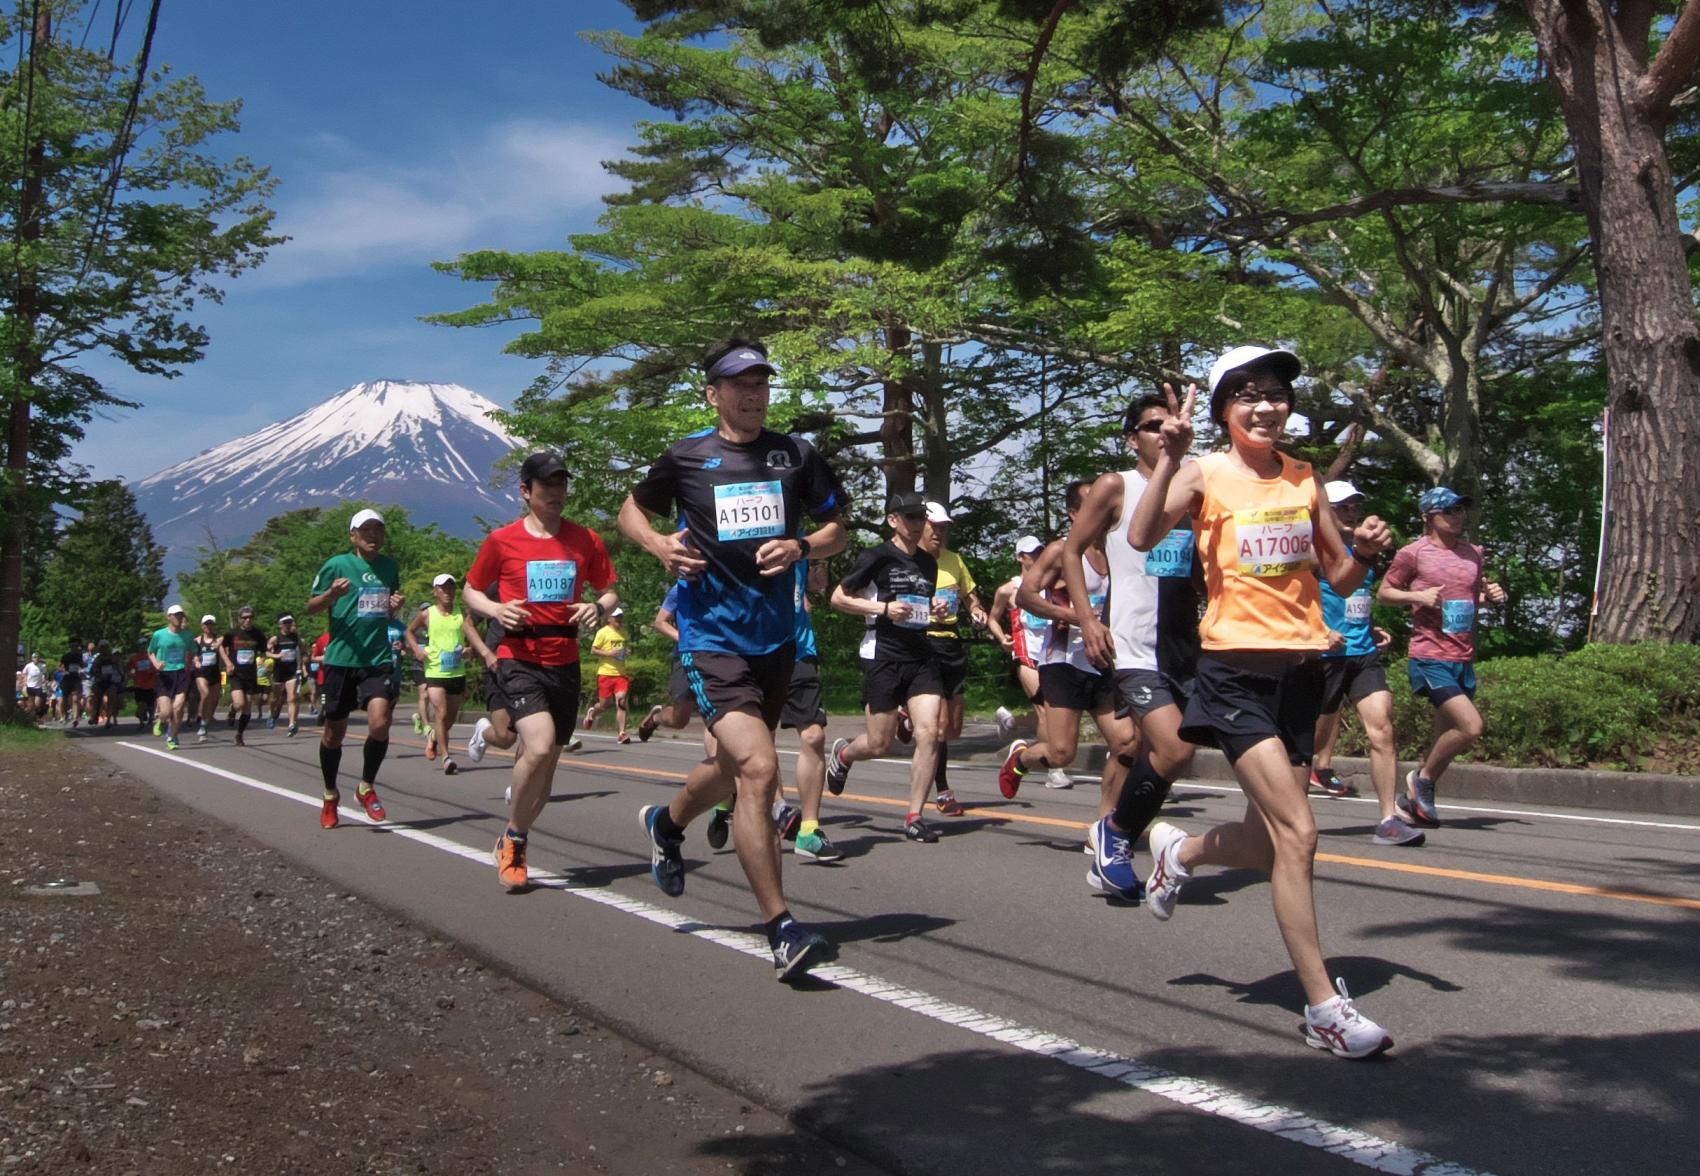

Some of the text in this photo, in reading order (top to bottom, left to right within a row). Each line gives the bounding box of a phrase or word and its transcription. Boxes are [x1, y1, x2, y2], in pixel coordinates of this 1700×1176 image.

[737, 496, 763, 504] ハーフ
[719, 505, 780, 524] A15101
[1262, 524, 1293, 534] ハーフ
[1240, 534, 1309, 557] A17006
[529, 578, 575, 590] A10187
